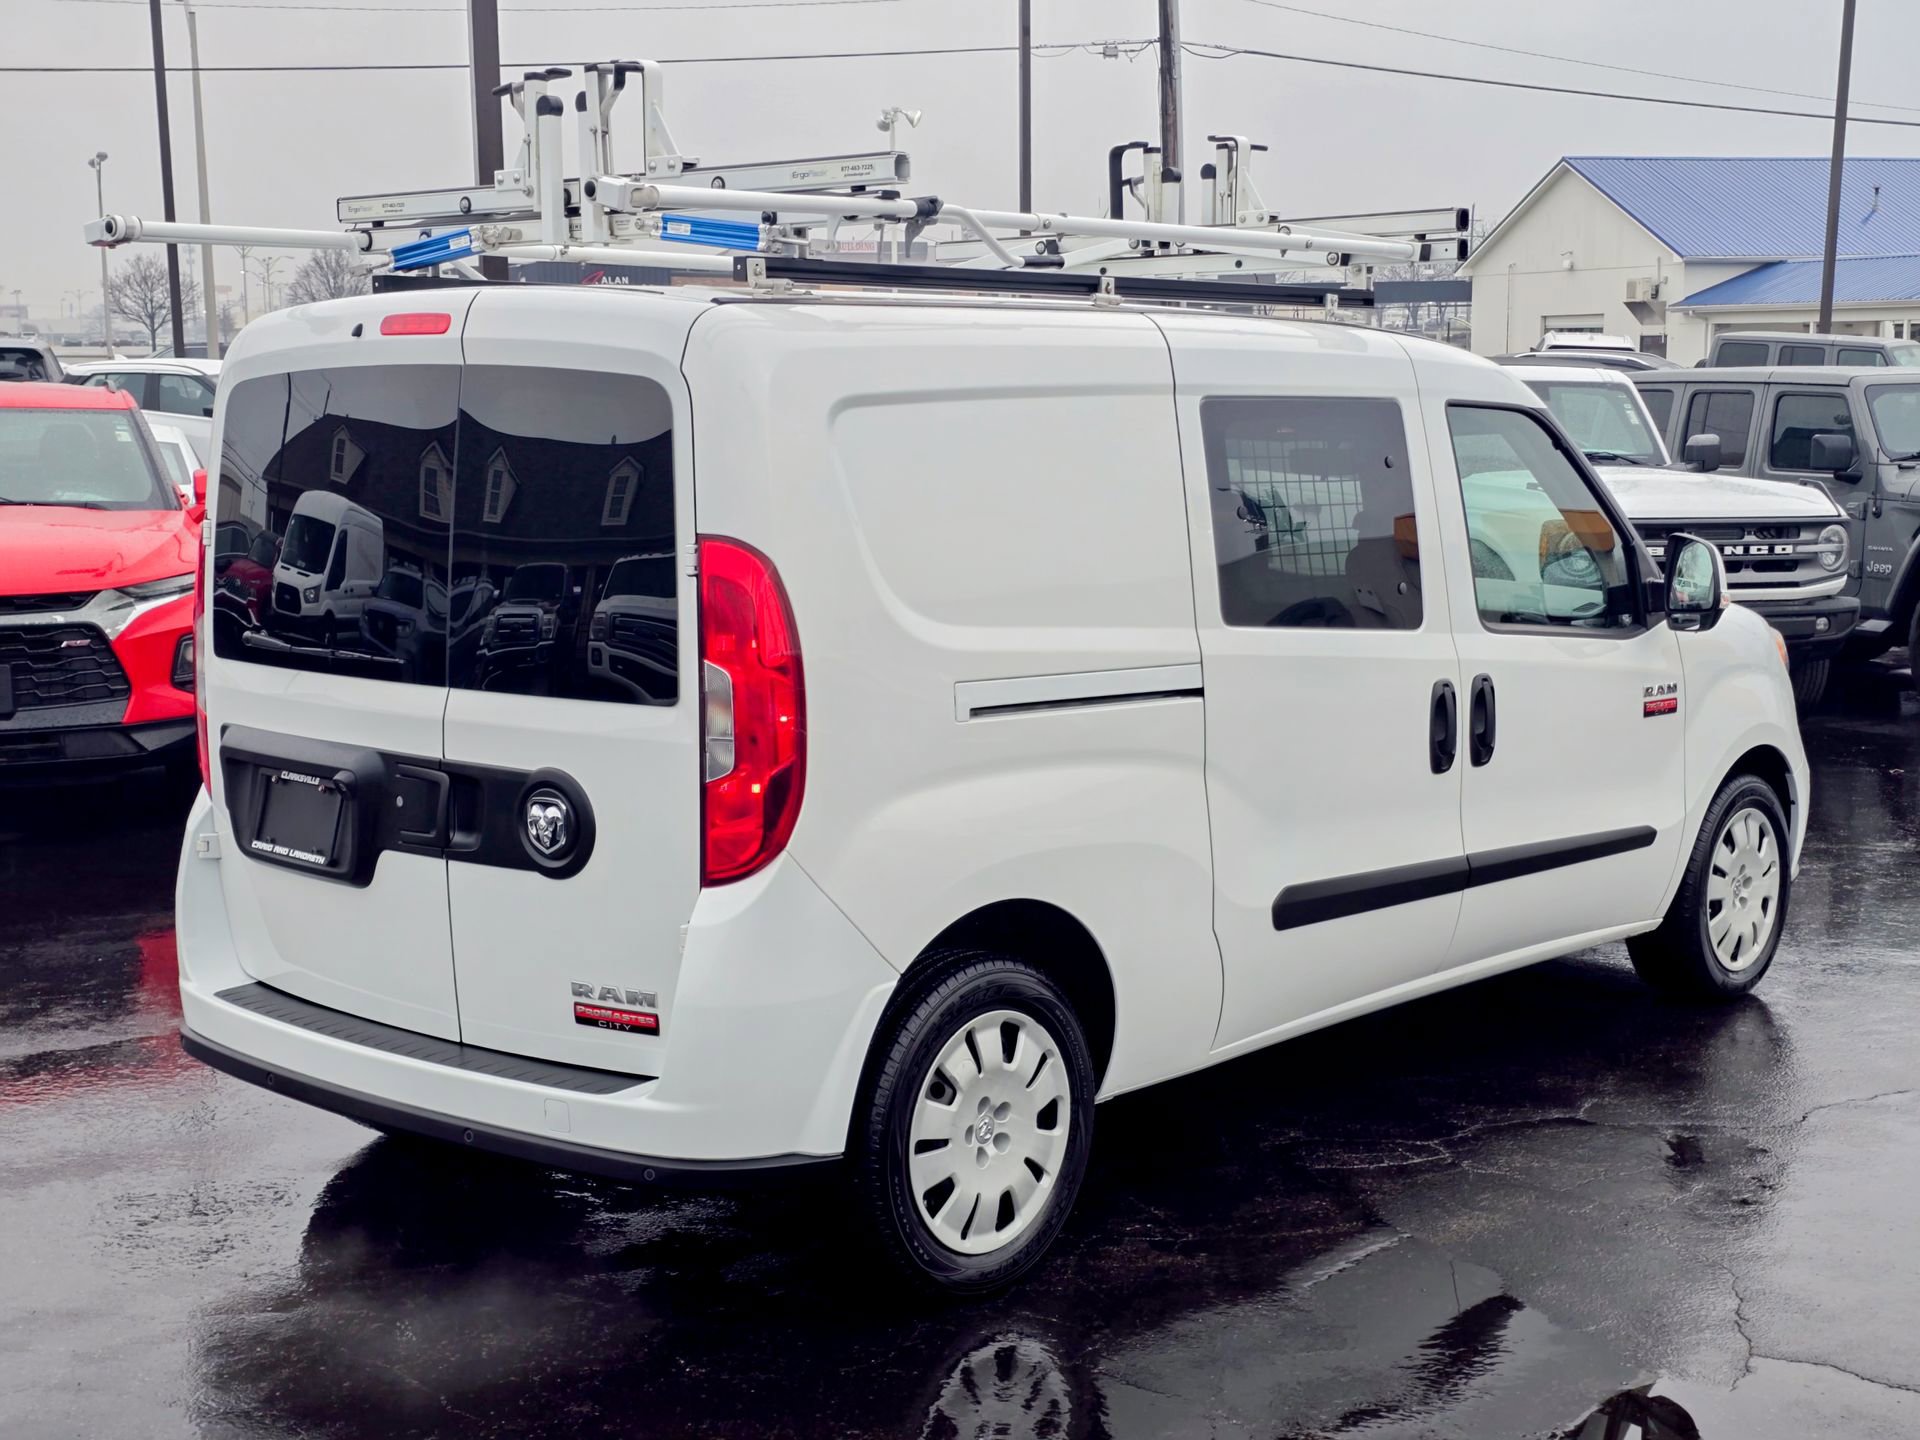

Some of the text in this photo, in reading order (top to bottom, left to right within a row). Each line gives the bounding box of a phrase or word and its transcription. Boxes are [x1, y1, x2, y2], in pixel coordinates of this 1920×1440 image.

[601, 275, 629, 284] ALAN
[1646, 544, 1793, 556] BNCO
[1866, 560, 1892, 575] Jeep
[1643, 682, 1678, 697] RAM
[280, 770, 320, 785] CLARKSVILLE
[251, 840, 326, 865] CRAIG AND LANDRETH
[571, 980, 658, 1009] RAM
[598, 1020, 632, 1031] CITY
